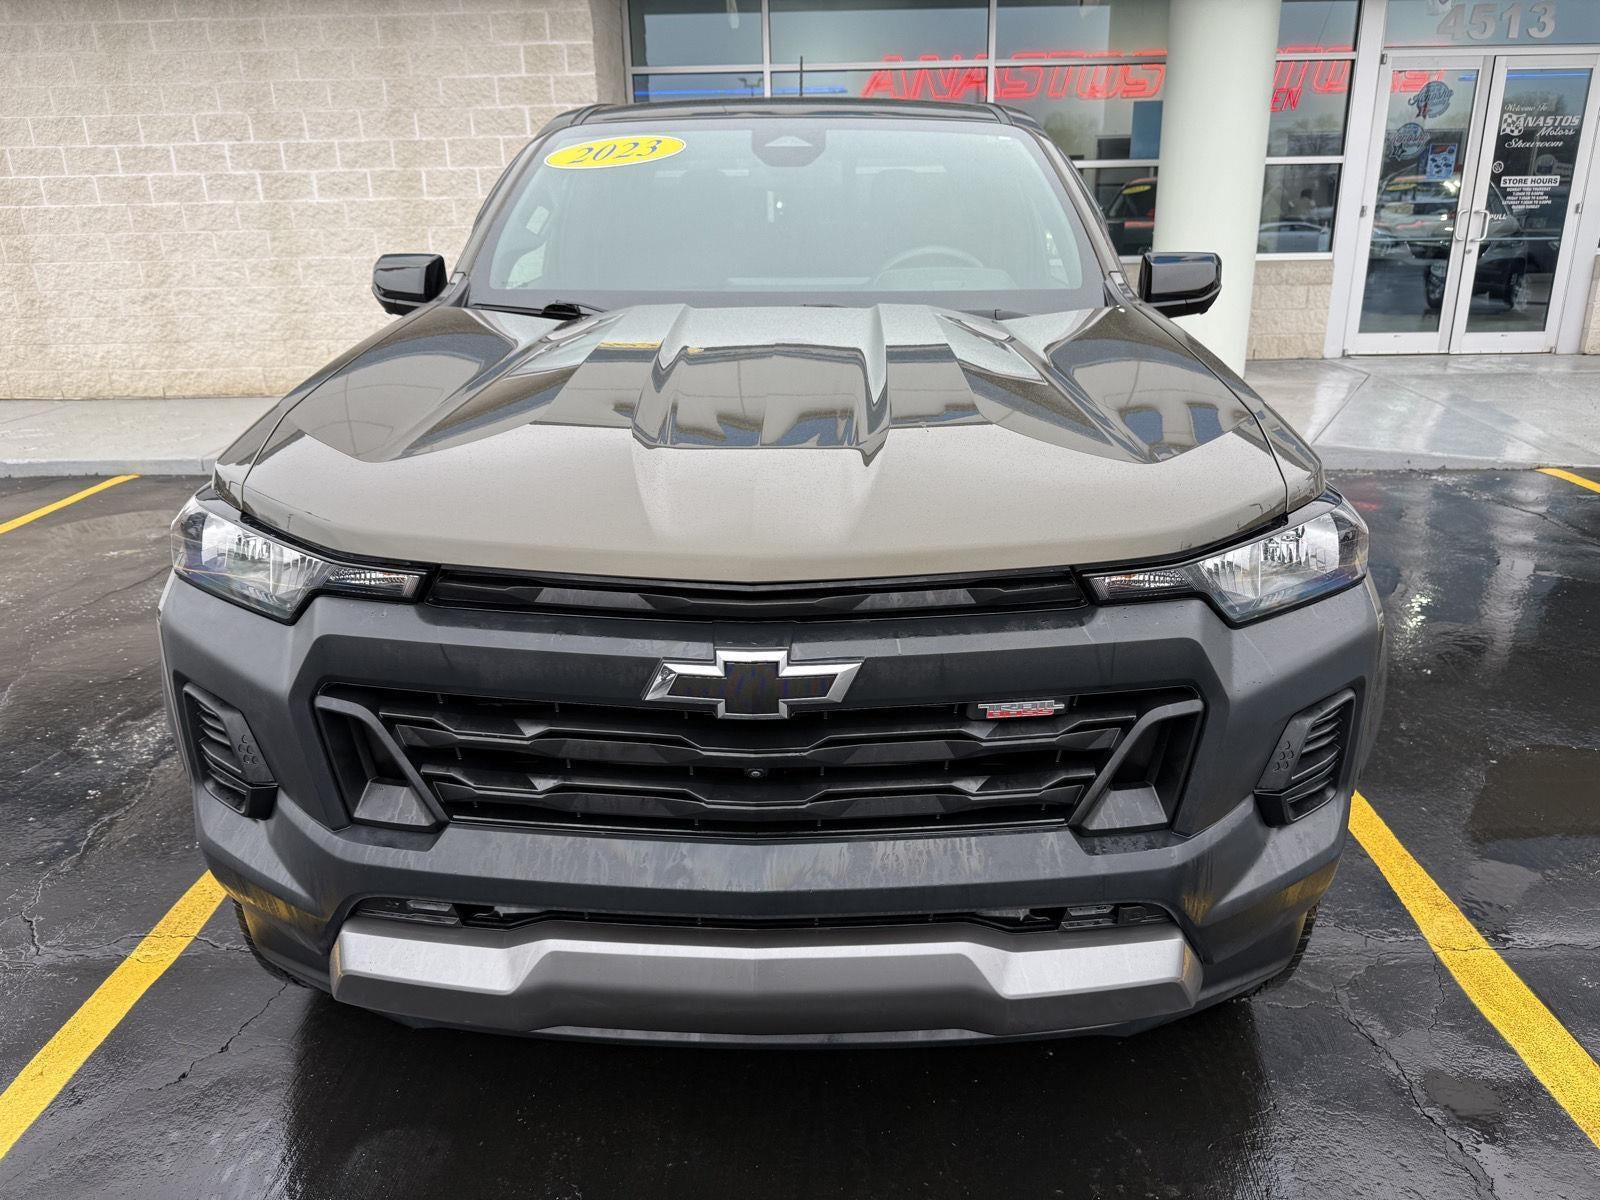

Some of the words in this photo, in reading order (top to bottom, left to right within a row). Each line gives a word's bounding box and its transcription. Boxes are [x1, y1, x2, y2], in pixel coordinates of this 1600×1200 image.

[1437, 2, 1556, 40] 4513
[860, 50, 1168, 100] ANASTOS
[1514, 114, 1581, 128] ANASTOS
[1536, 126, 1576, 137] Motors
[568, 139, 663, 165] 2023
[1502, 178, 1529, 186] STORE
[1530, 177, 1559, 185] HOURS
